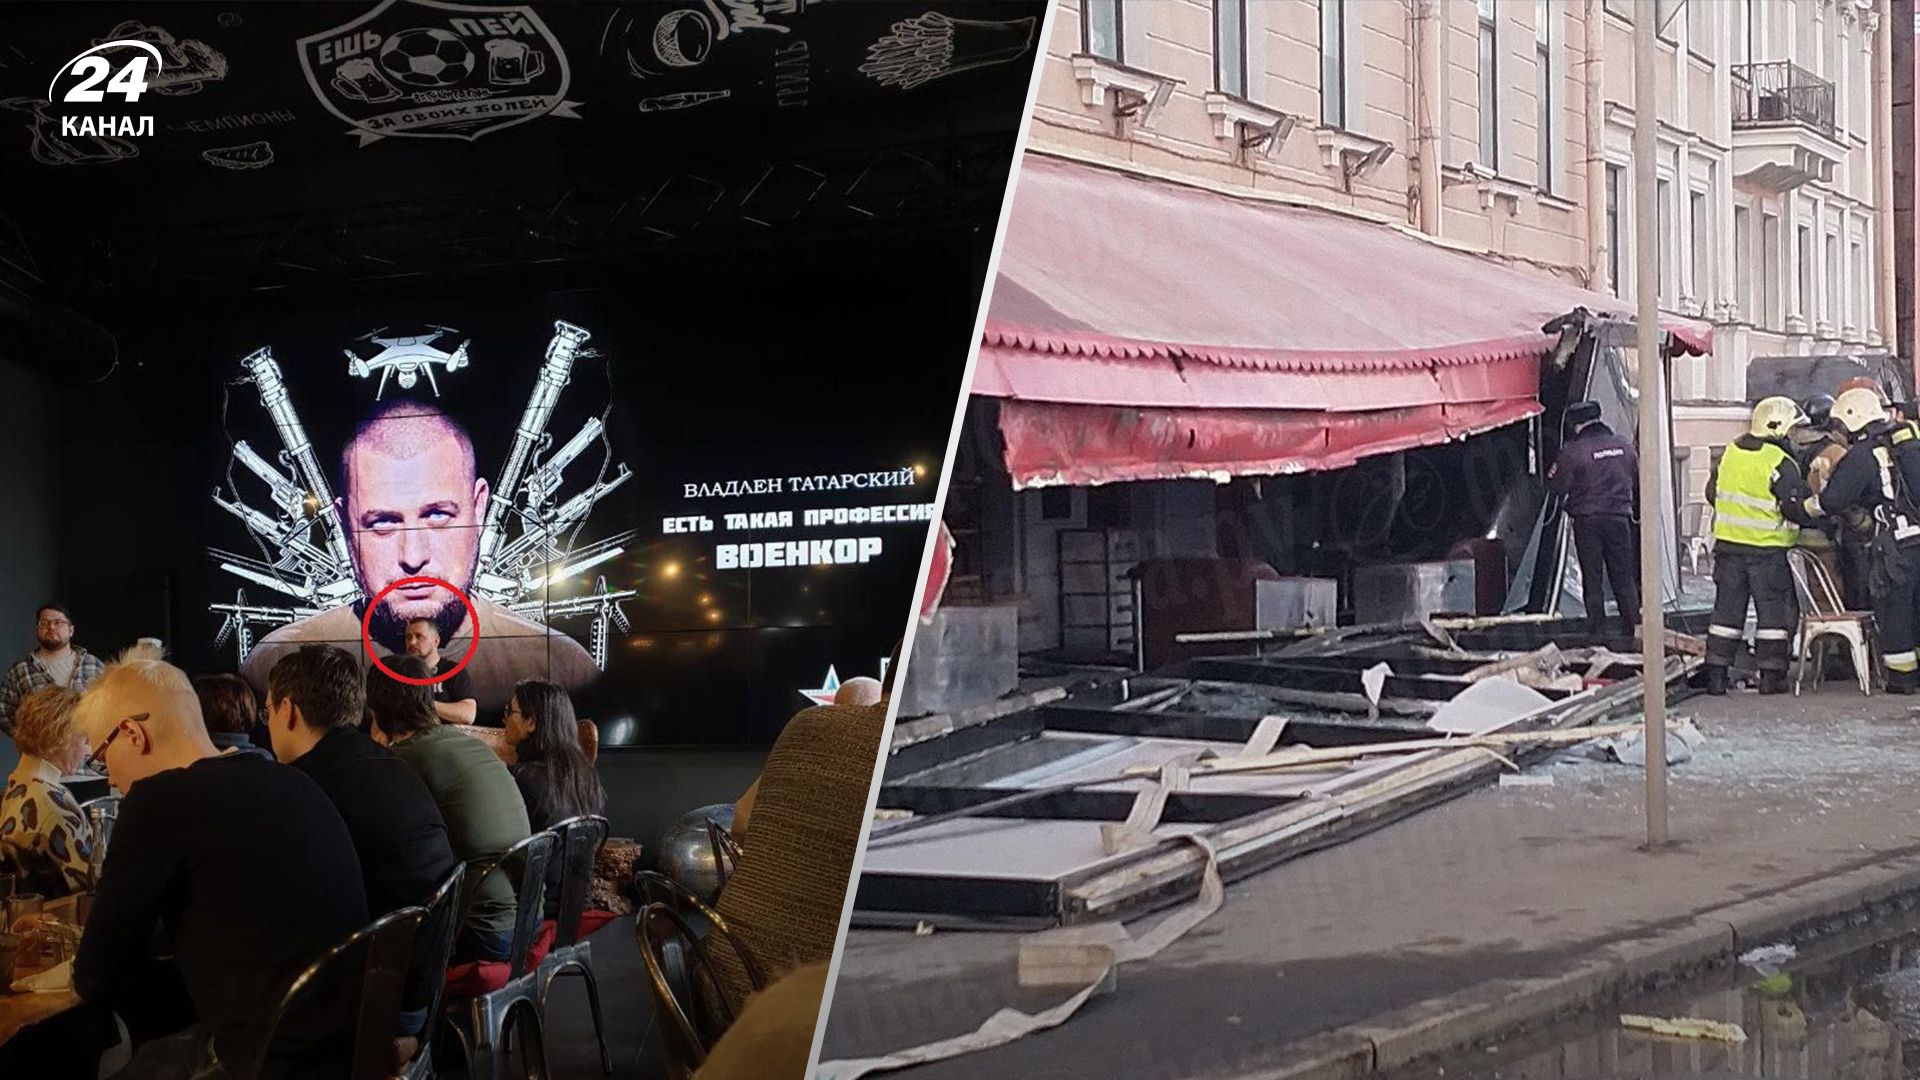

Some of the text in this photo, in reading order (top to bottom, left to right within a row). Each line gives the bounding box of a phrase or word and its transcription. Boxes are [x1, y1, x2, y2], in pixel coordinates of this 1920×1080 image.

[449, 13, 536, 37] ПЕЙ
[317, 29, 383, 65] ЕШЬ
[367, 97, 548, 130] ЗА СВОИХ БОЛЕЙ
[684, 468, 915, 498] ВЛАДЛЕН ТАТАРСКИЙ
[662, 515, 714, 534] ЕСТЬ
[723, 511, 793, 531] ТАКАЯ
[716, 537, 883, 570] ВОЕНКОР
